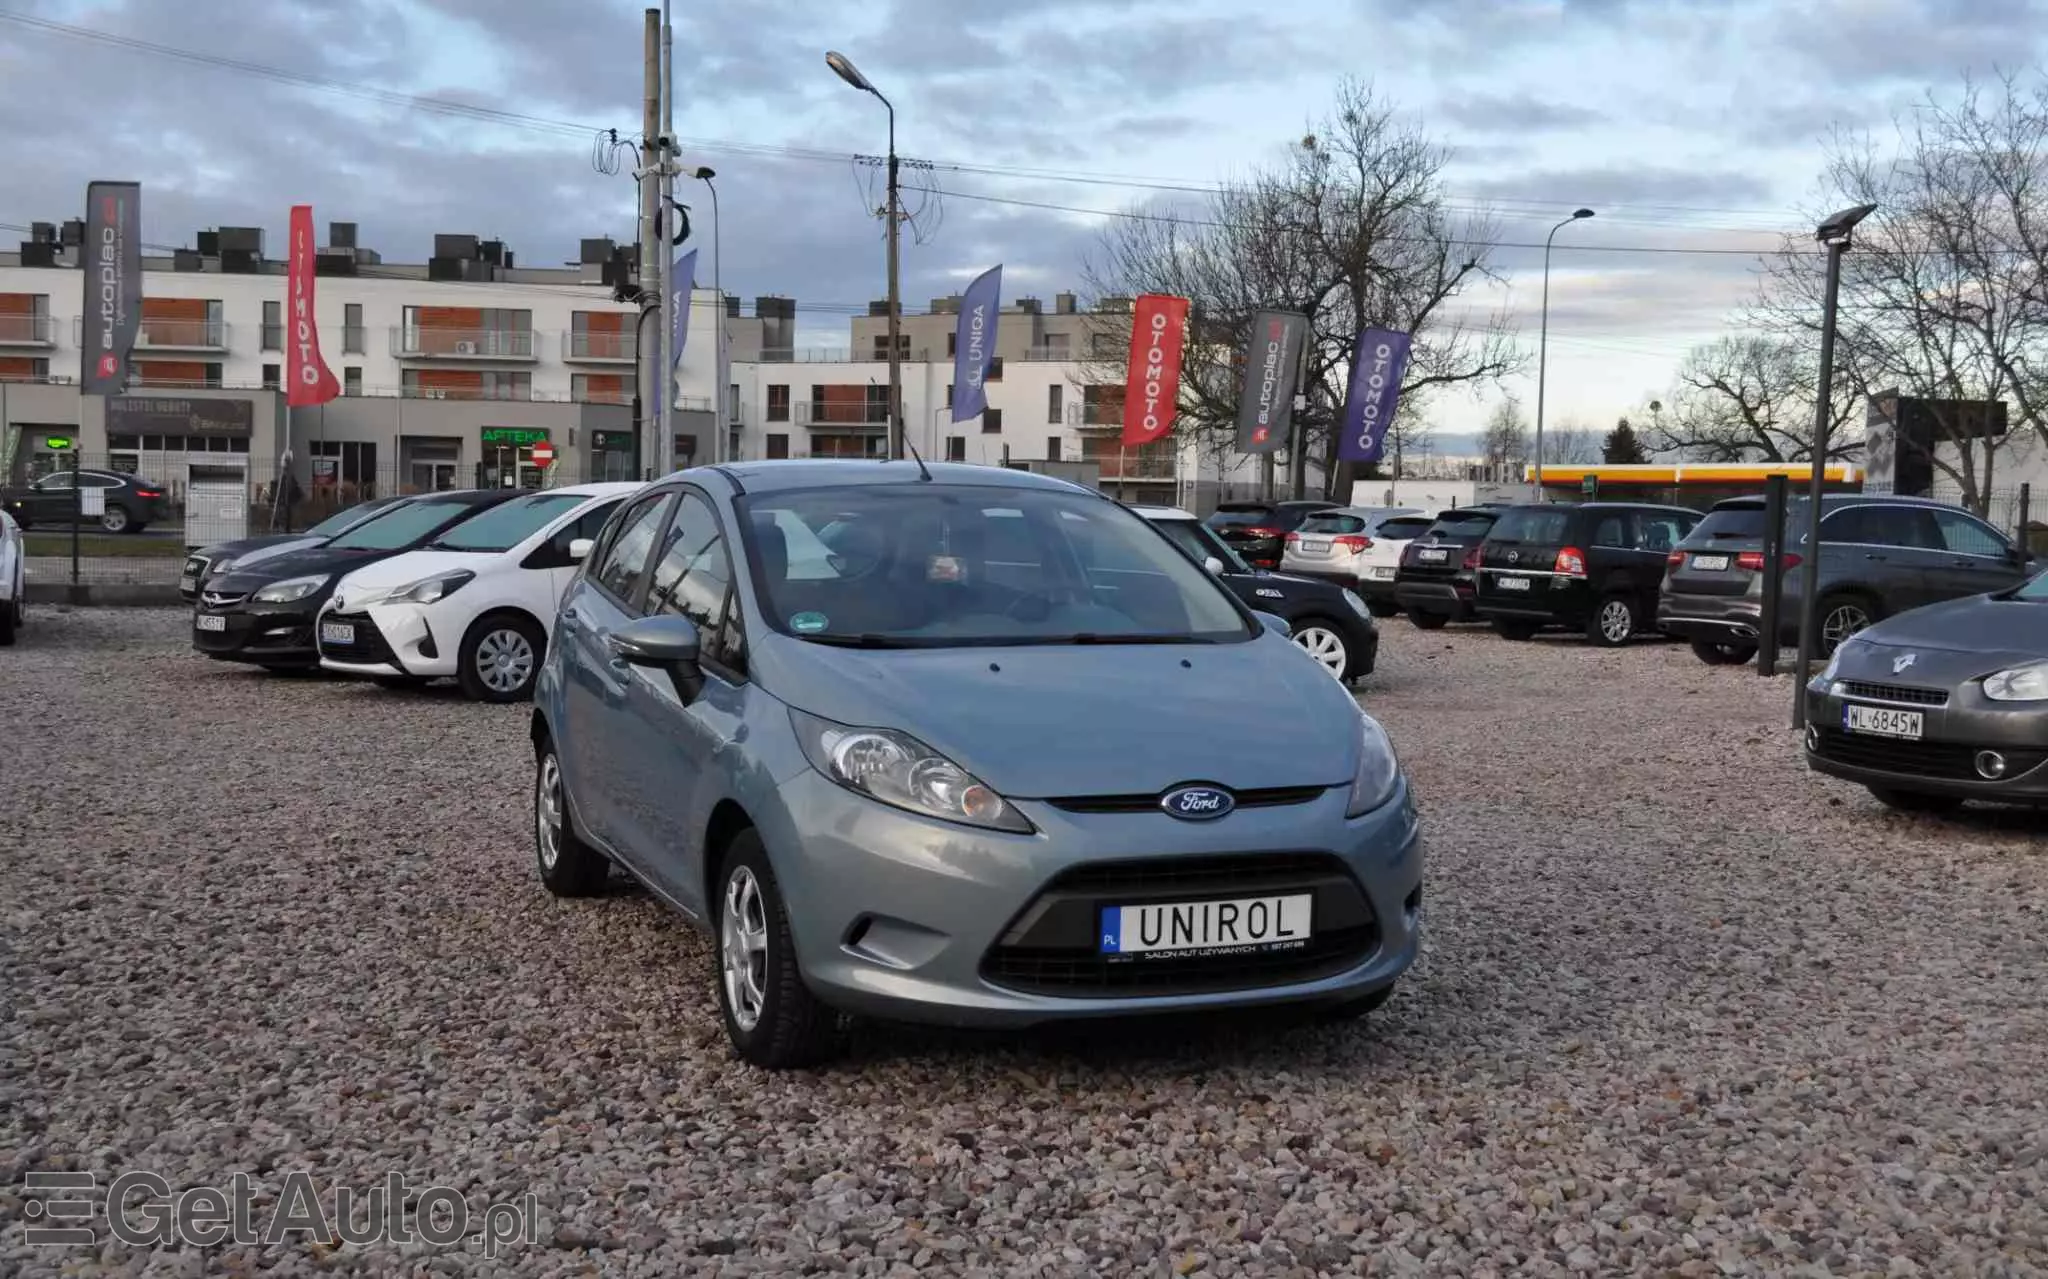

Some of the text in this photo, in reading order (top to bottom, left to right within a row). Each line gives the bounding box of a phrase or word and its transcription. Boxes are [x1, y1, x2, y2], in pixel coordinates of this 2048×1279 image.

[969, 304, 984, 361] UNIQA
[1143, 313, 1167, 430] OTOMOTO
[1358, 344, 1391, 449] OTOMOTO
[482, 429, 547, 442] APTEKA
[1872, 710, 1919, 734] 6845W
[1180, 791, 1220, 810] Ford
[1104, 935, 1117, 944] PL
[1140, 900, 1294, 946] UNIROL
